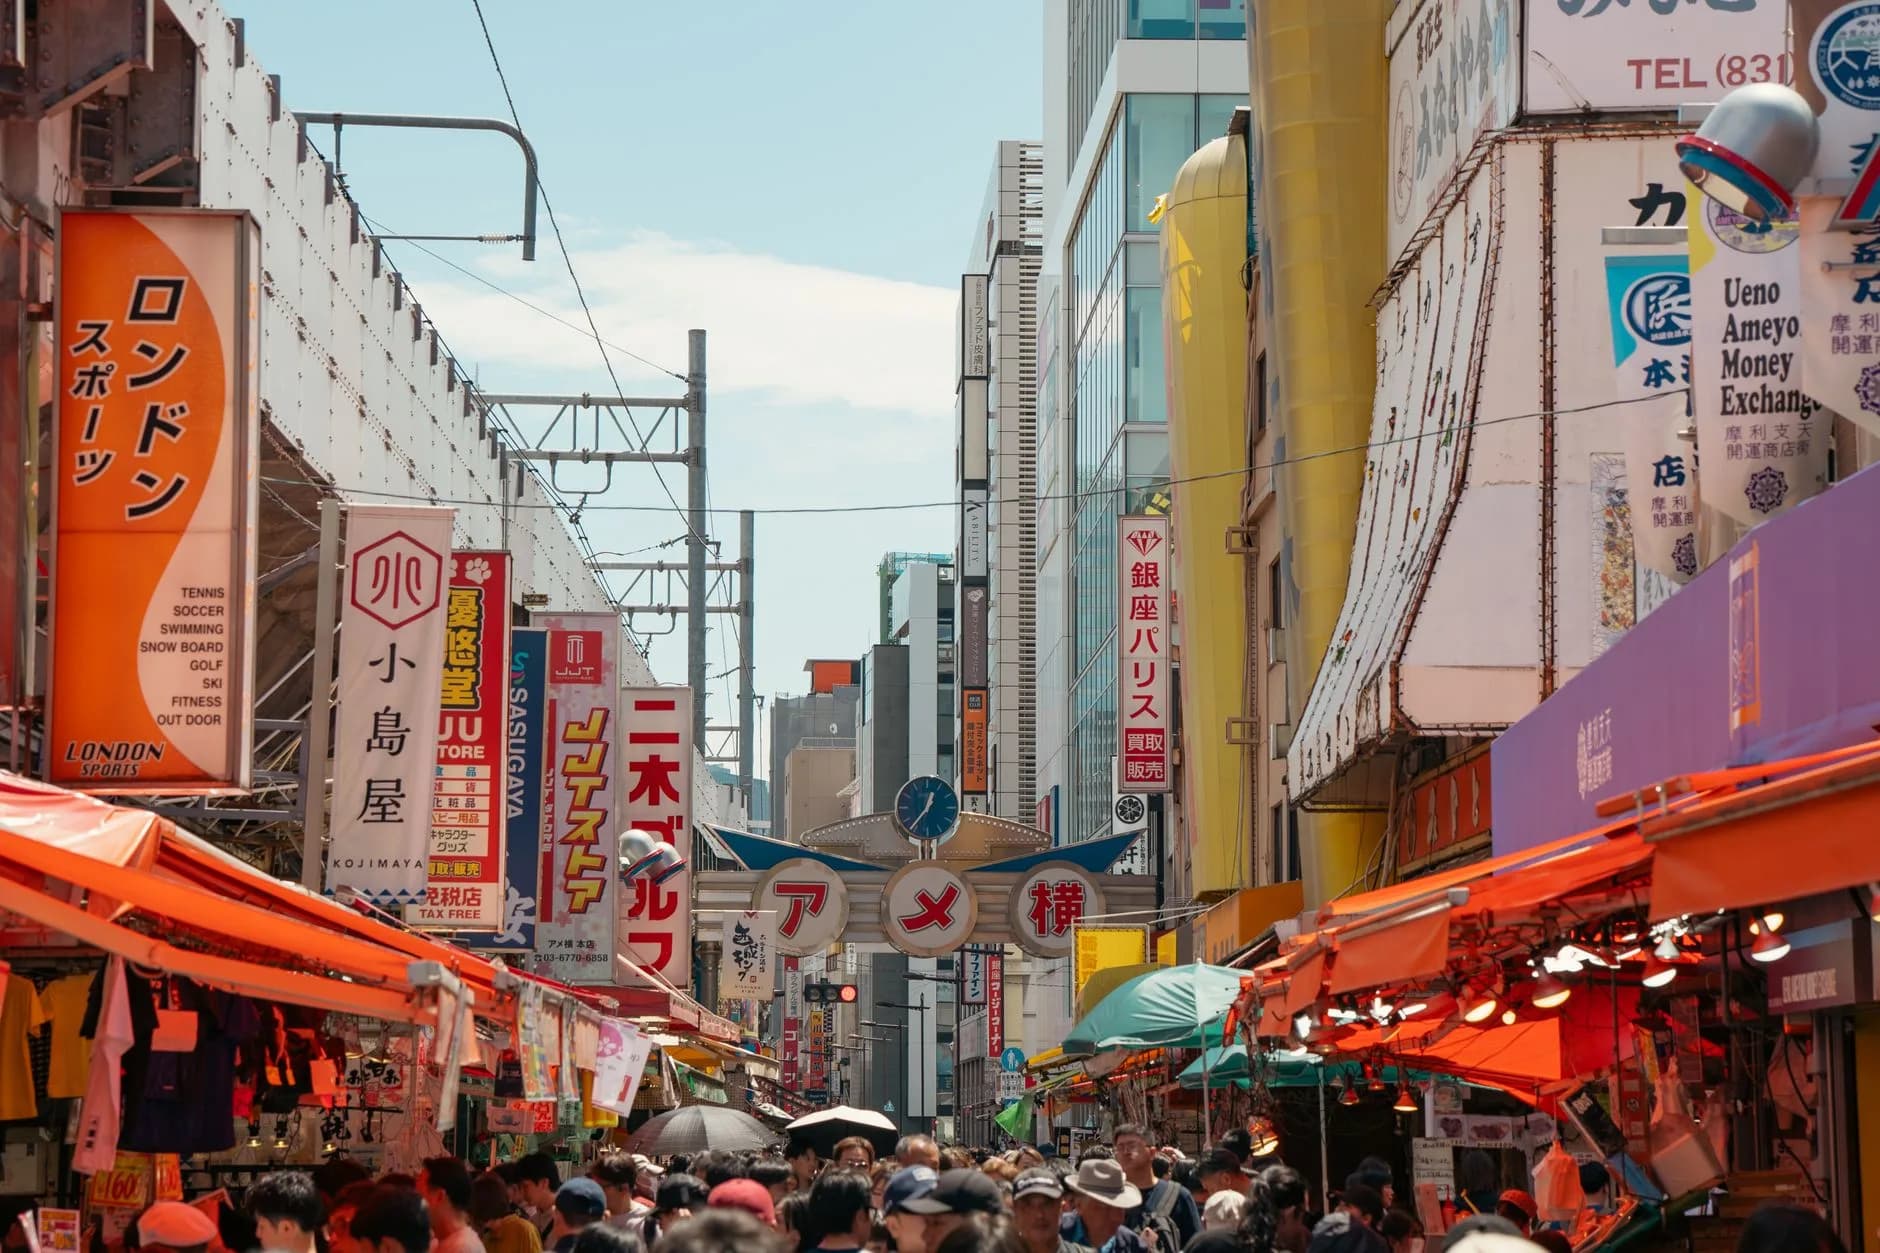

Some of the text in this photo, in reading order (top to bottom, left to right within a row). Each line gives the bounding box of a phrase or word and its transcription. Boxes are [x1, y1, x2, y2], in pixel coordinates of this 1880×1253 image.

[1627, 58, 1707, 89] TEL
[1724, 278, 1780, 308] Ueno
[1722, 313, 1800, 346] Ameyo
[1720, 348, 1794, 382] Money
[70, 319, 118, 487] スポーツ
[125, 276, 188, 521] ロンドン
[181, 588, 225, 599] TENNIS
[173, 606, 224, 617] SOCCER
[160, 624, 224, 635] SWIMMING
[140, 642, 224, 653] SNOW BOARD
[1129, 562, 1160, 720] 銀座パリス
[190, 660, 223, 671] GOLF
[202, 678, 223, 689] SKI
[171, 696, 222, 707] FITNESS
[157, 714, 222, 725] OUT DOOR
[356, 643, 417, 825] 小島屋
[1127, 733, 1164, 752] 買取
[65, 741, 165, 761] LONDON
[437, 745, 485, 760] TORE
[507, 687, 529, 820] SASUGAYA
[80, 763, 139, 777] SPORTS
[1127, 760, 1164, 779] 販売
[437, 842, 467, 853] グッズ
[333, 859, 424, 869] KOJIMAYA
[420, 909, 481, 919] TAX FREE
[773, 880, 1084, 939] アメ横
